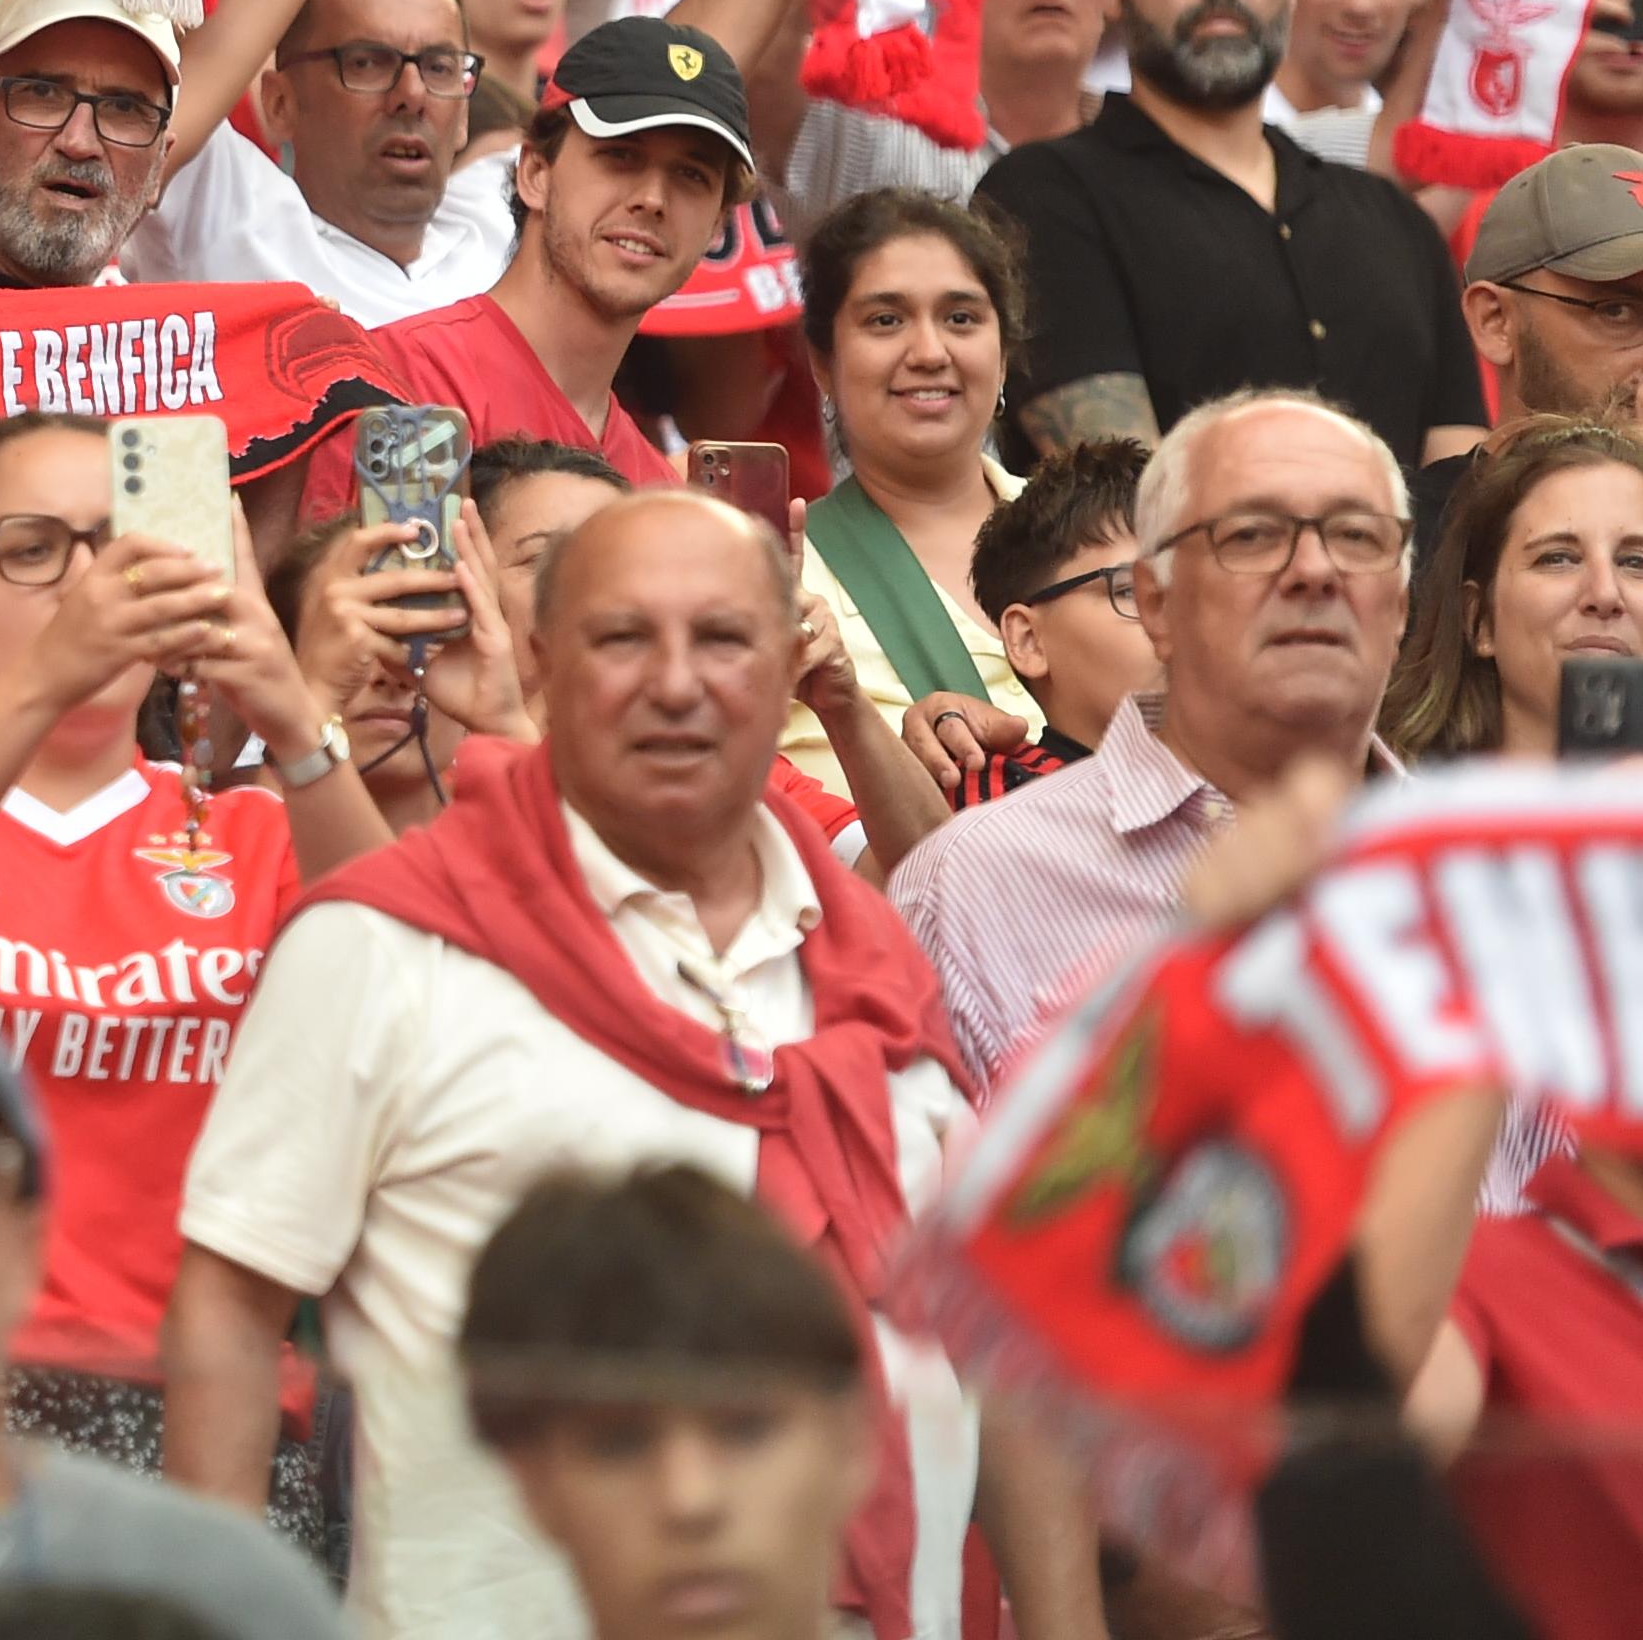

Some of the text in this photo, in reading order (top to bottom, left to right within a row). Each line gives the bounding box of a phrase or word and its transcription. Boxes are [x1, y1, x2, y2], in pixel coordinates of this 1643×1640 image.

[0, 334, 24, 421] E
[30, 311, 224, 417] BENFICA
[52, 1014, 231, 1084] BETTER
